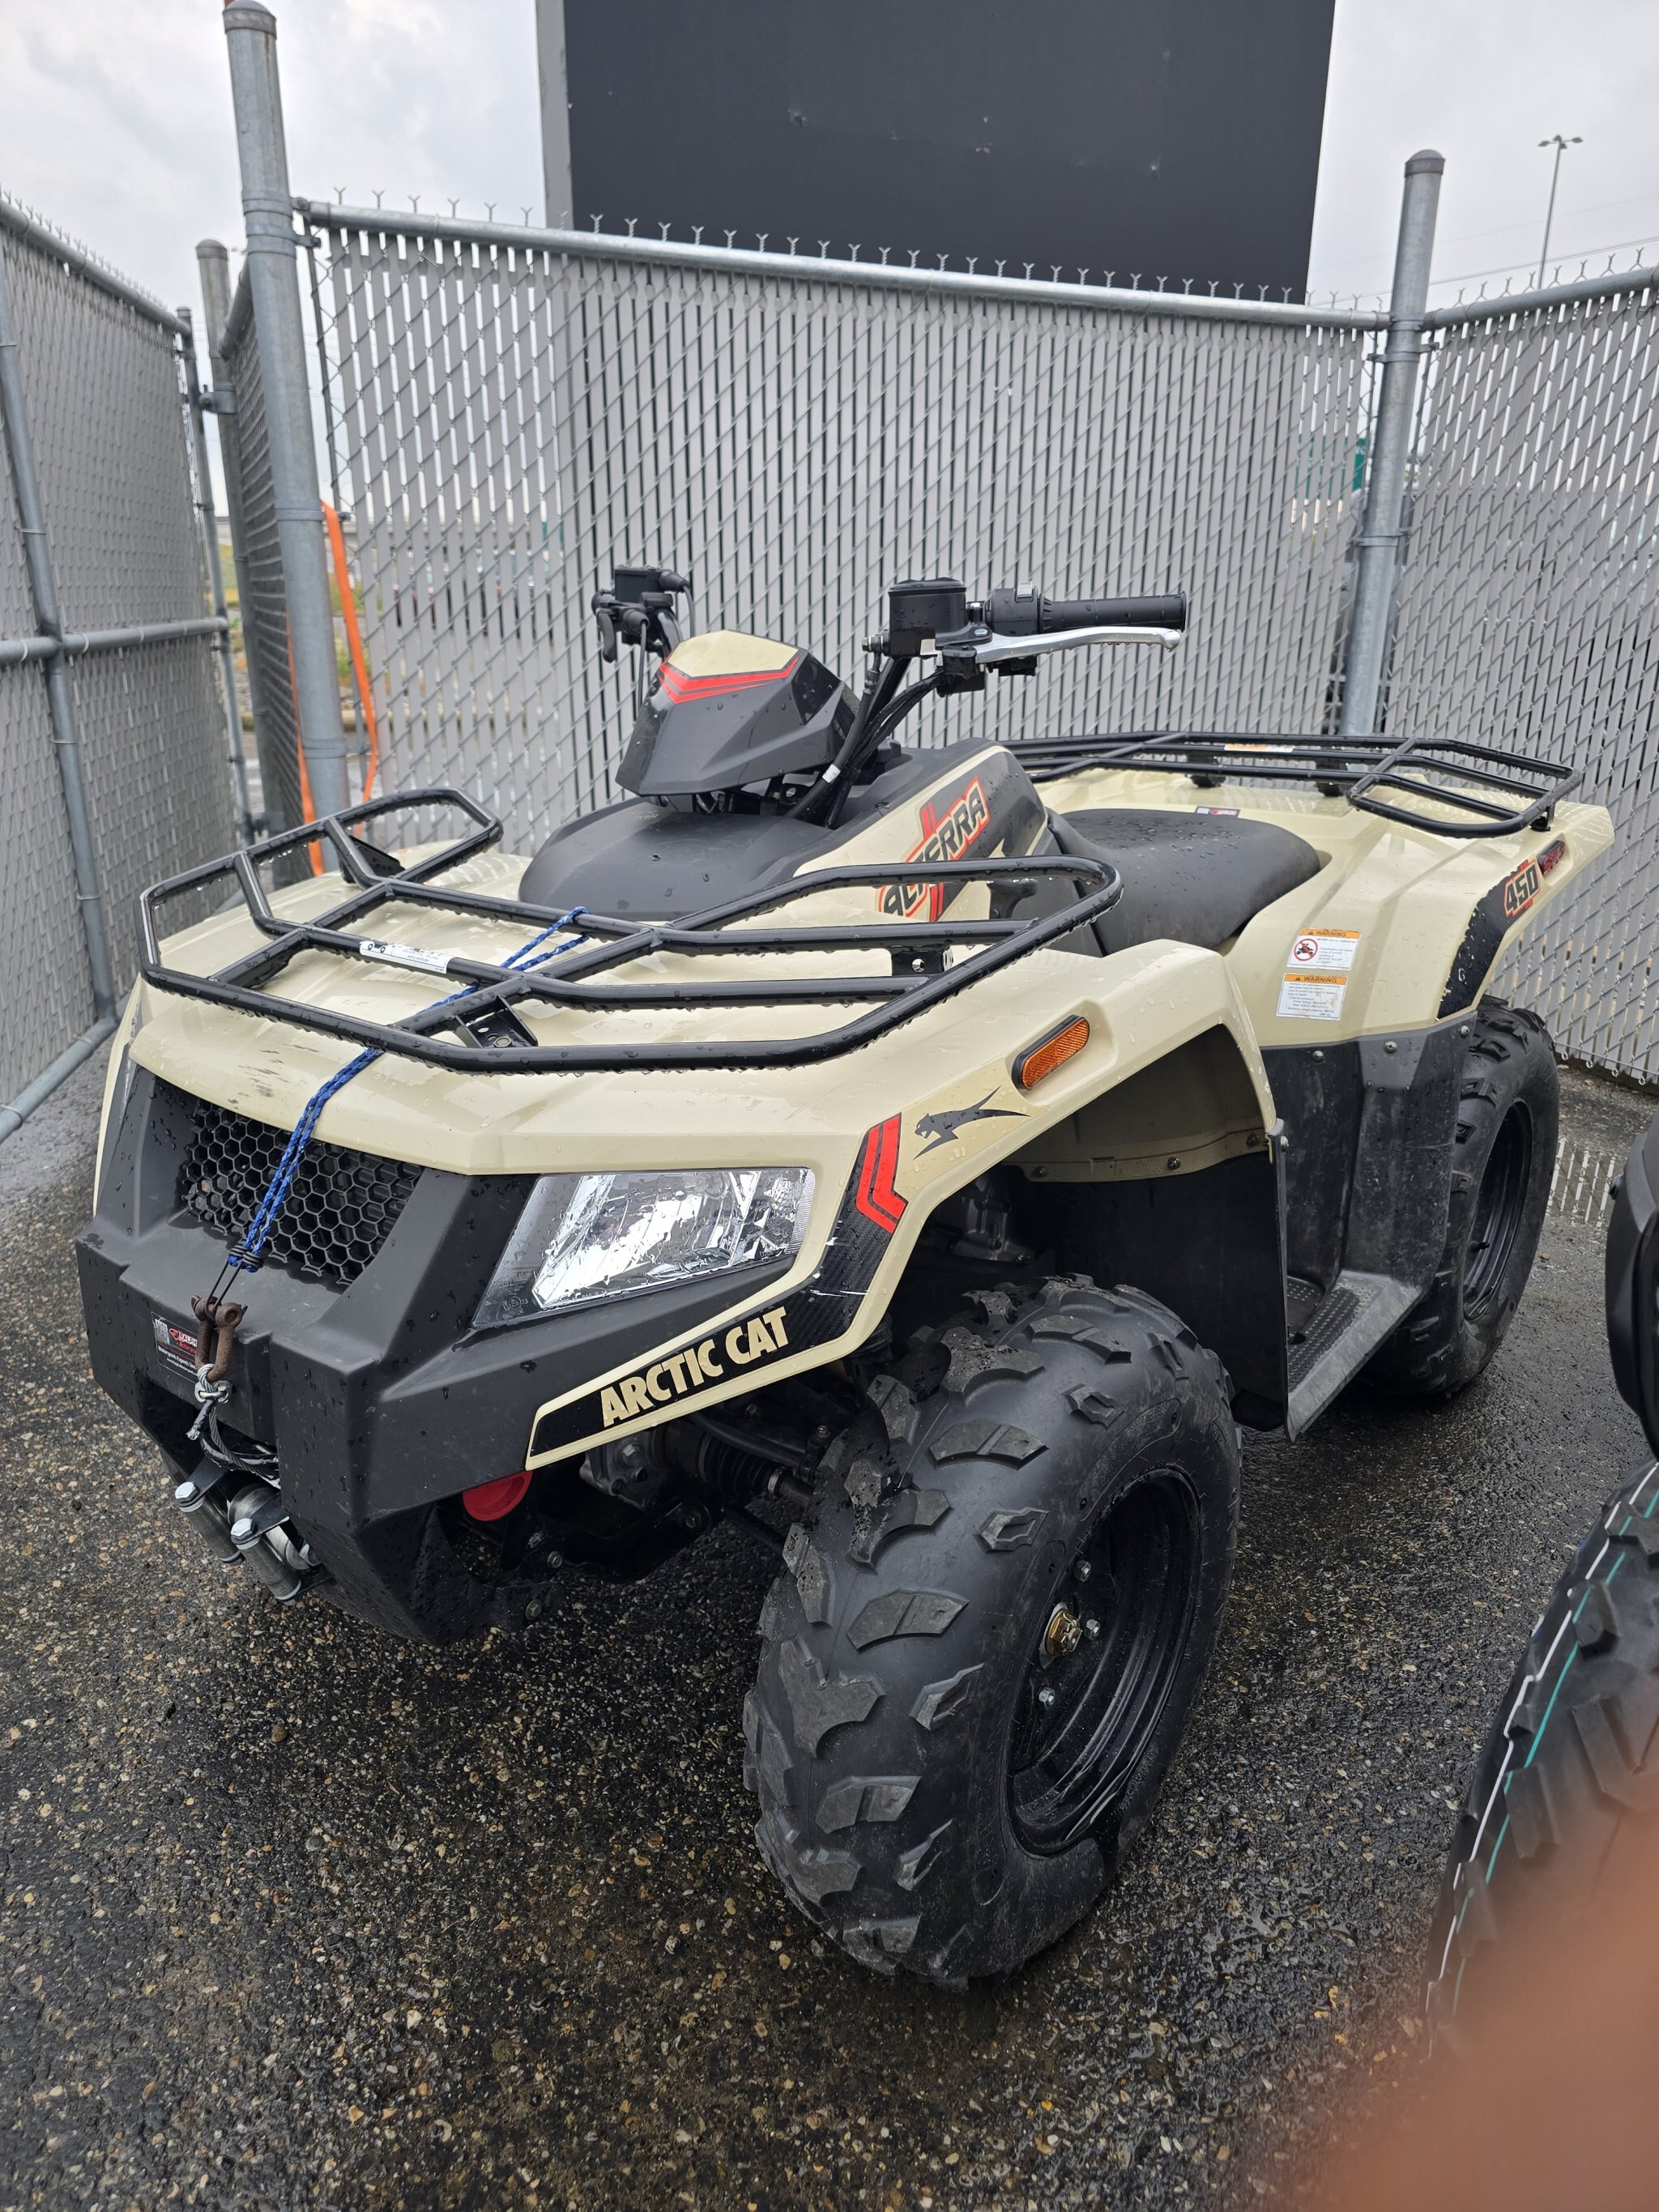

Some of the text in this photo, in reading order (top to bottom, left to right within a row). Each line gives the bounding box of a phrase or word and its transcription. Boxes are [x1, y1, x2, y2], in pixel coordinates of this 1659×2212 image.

[1506, 865, 1539, 912] 450
[600, 1306, 790, 1428] ARCTIC CAT
